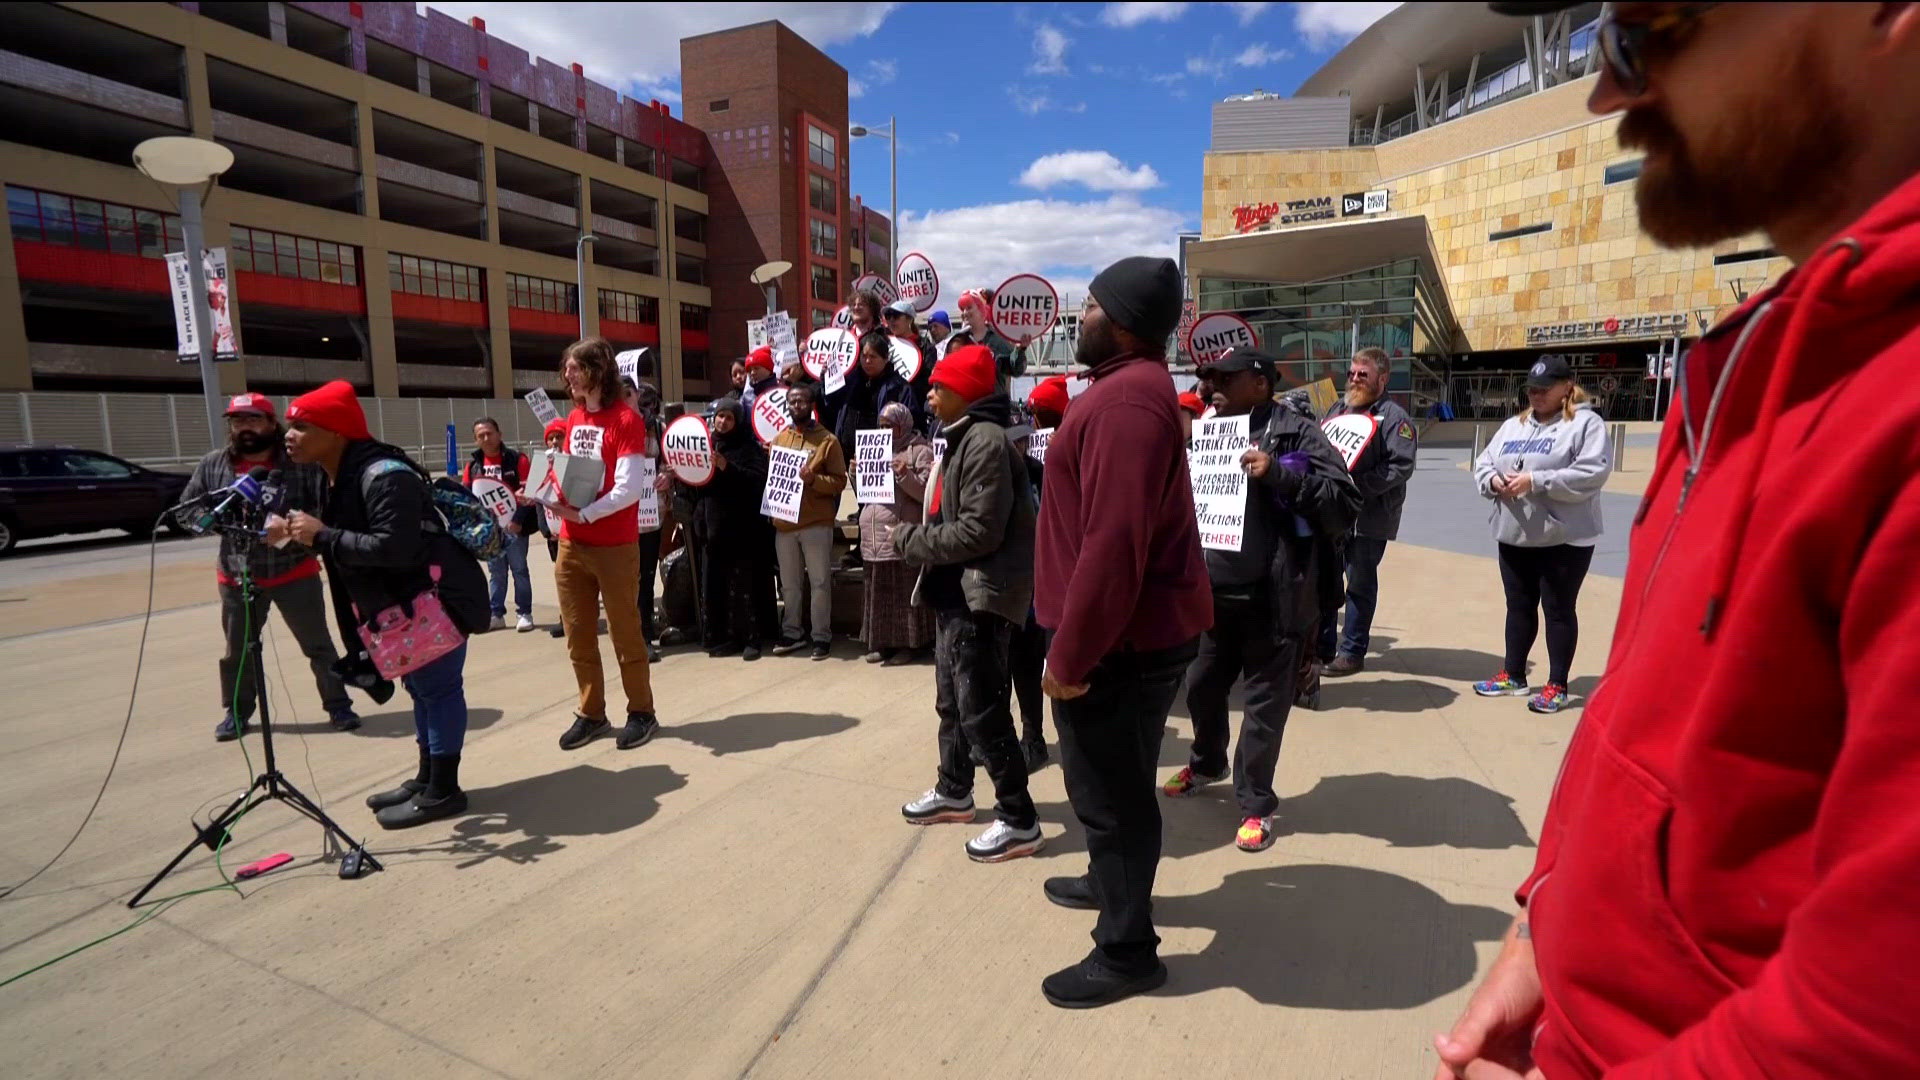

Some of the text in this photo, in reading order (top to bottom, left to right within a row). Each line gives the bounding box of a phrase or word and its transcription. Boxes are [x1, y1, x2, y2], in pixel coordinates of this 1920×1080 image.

[1286, 197, 1332, 211] TEAM
[1367, 193, 1385, 203] NEW
[1232, 202, 1279, 234] Twins
[1281, 209, 1337, 224] STORE
[898, 268, 933, 286] UNITE
[997, 295, 1053, 310] UNITE
[183, 306, 193, 333] PLACE
[1527, 314, 1687, 336] TARGET FIELD
[1192, 326, 1249, 351] UNITE
[888, 342, 911, 378] NITE
[573, 429, 600, 441] ONE
[1203, 421, 1238, 436] WE WILL
[1323, 422, 1365, 450] UNITE
[573, 441, 595, 450] JOB
[666, 434, 708, 451] UNITE
[857, 433, 892, 447] TARGET
[1194, 437, 1225, 452] STRIKE
[771, 450, 806, 468] TARGET
[859, 447, 884, 460] FIELD
[1219, 455, 1233, 466] PAY
[771, 463, 797, 479] FIELD
[858, 461, 891, 474] STRIKE
[768, 476, 802, 493] STRIKE
[862, 474, 885, 487] VOTE
[261, 485, 278, 495] FOX
[481, 486, 508, 506] ITE
[768, 489, 793, 505] VOTE
[261, 493, 273, 505] 9
[1195, 503, 1208, 513] OB
